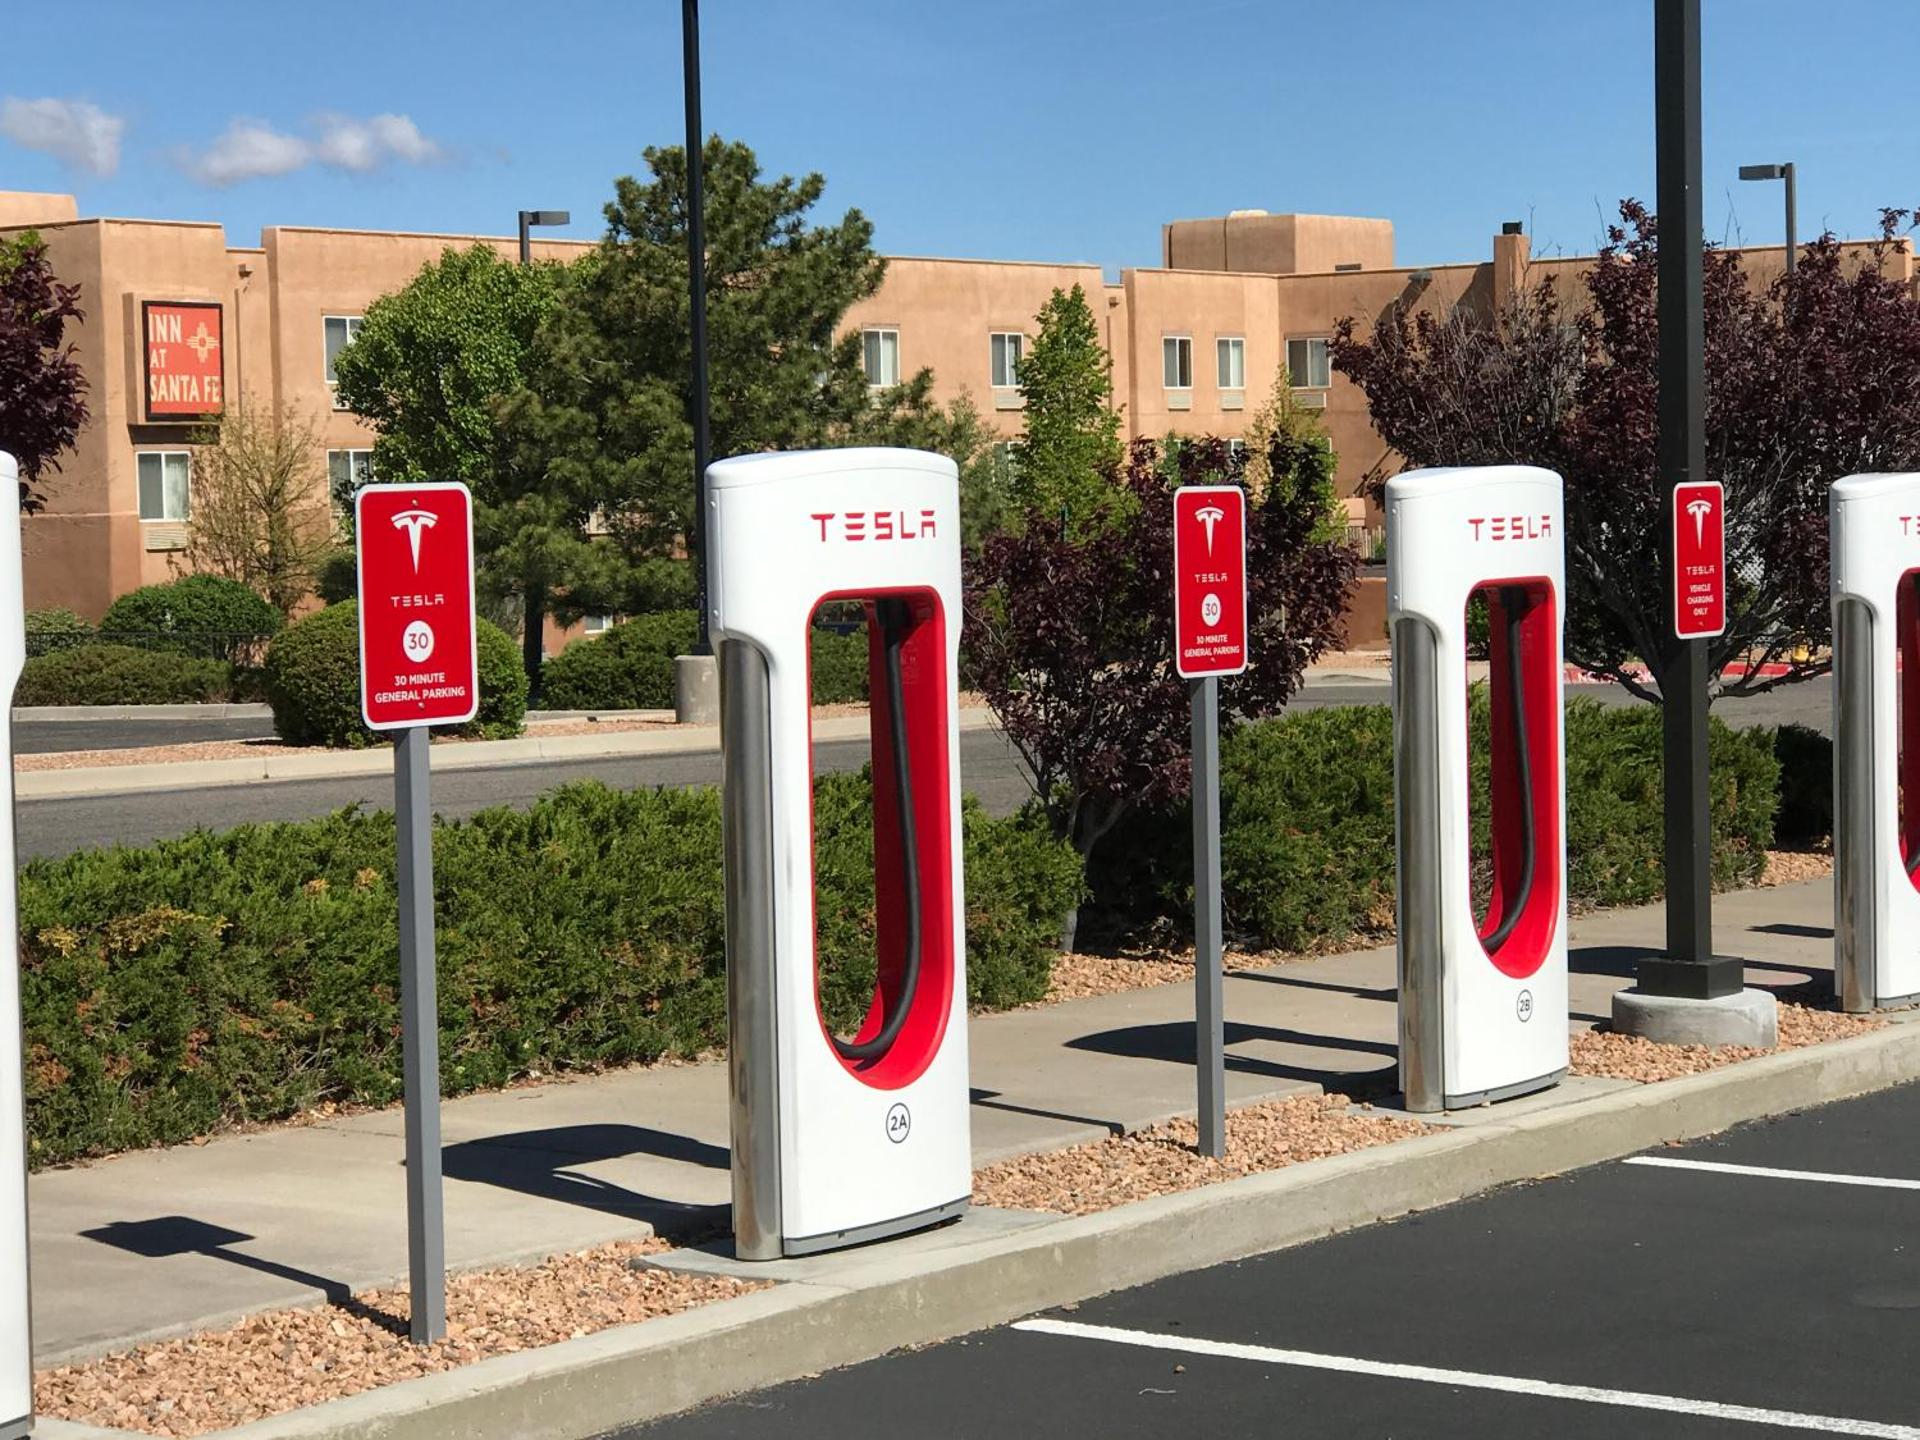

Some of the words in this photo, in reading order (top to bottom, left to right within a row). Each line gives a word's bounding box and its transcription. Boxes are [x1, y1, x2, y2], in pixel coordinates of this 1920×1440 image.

[148, 313, 182, 343] INN
[150, 348, 167, 369] AT
[150, 374, 200, 403] SANTA
[203, 375, 221, 403] FE
[810, 510, 936, 542] TESLA
[1467, 515, 1551, 541] TESLA
[1194, 572, 1228, 583] TESLA
[1685, 564, 1715, 576] TESLA
[391, 594, 444, 608] TESLA
[1205, 602, 1219, 617] 30
[408, 632, 429, 650] 30
[1206, 634, 1229, 644] MINUTE
[1184, 648, 1213, 658] GENERAL
[1213, 645, 1240, 655] PARKING
[394, 675, 407, 686] 30
[409, 672, 446, 685] MINUTE
[374, 690, 420, 704] GENERAL
[422, 686, 466, 700] PARKING
[1520, 999, 1531, 1012] 2B
[890, 1113, 908, 1132] 2A
